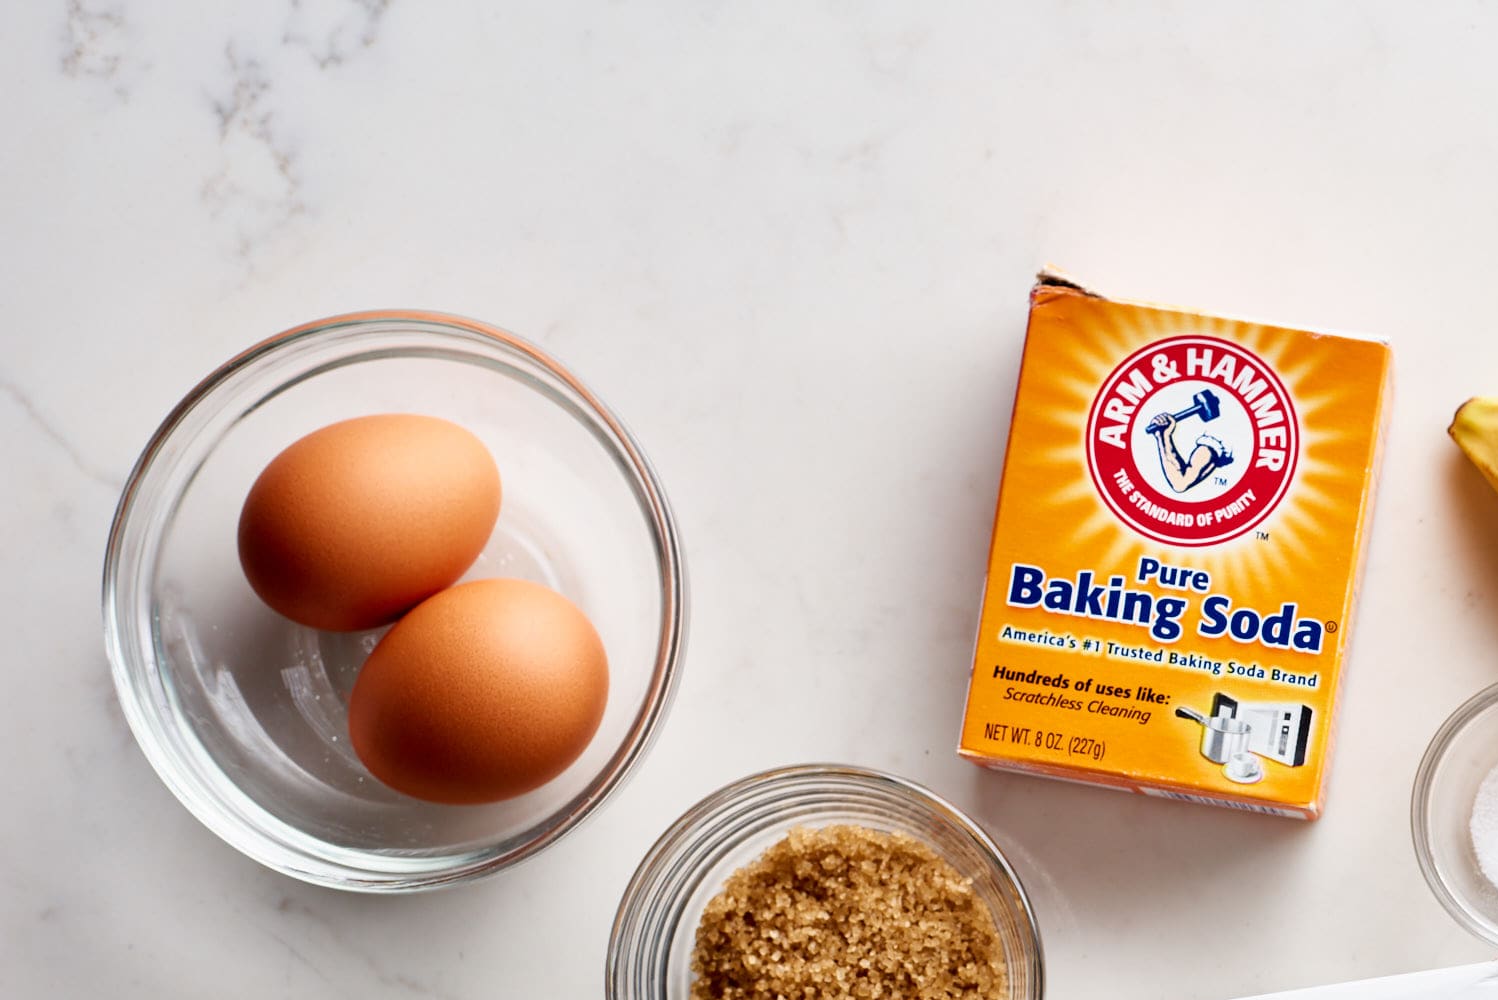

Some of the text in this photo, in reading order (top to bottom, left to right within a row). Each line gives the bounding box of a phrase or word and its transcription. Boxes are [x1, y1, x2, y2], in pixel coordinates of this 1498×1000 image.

[1099, 347, 1288, 473] ARM & HAMMER
[1112, 467, 1258, 528] THE STANDARD OF PURITY
[1137, 557, 1211, 592] Pure
[1008, 565, 1323, 652] Baking Soda
[1001, 626, 1318, 688] America's #1 Trusted Baking Soda Brand
[992, 665, 1172, 706] Hundreds of uses like:
[1003, 686, 1152, 726] Scratchless Cleaning
[984, 722, 1106, 761] NET WT. 8 OZ. (227g)
